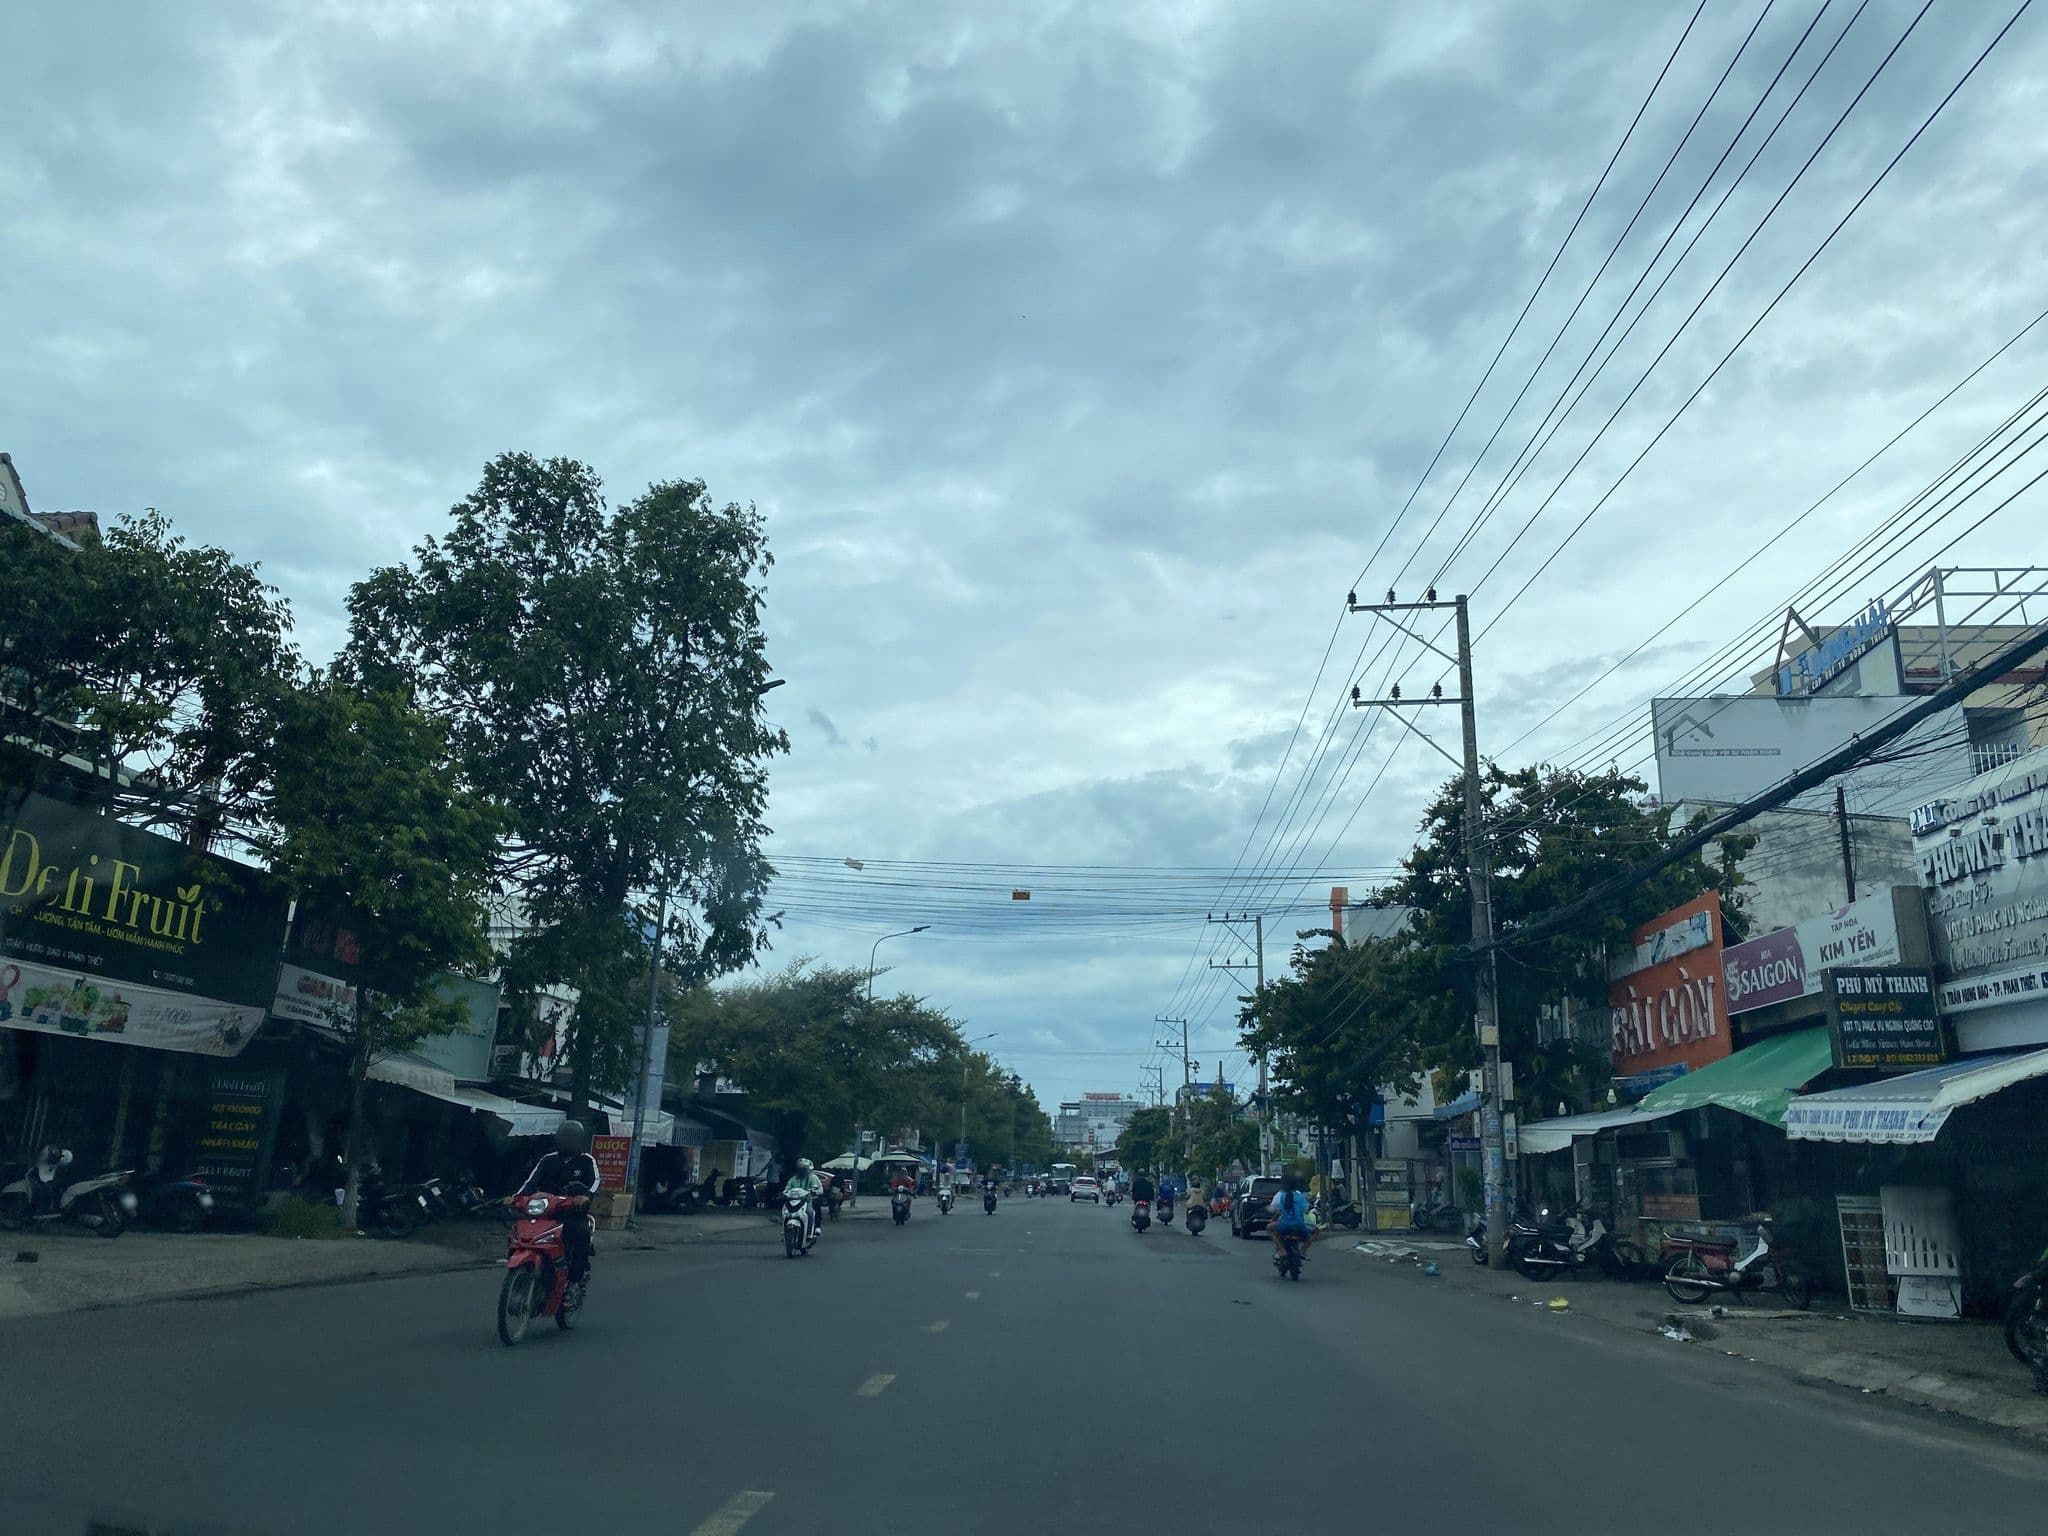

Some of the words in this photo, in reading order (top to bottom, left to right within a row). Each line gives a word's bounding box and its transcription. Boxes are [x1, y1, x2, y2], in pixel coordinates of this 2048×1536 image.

[102, 859, 207, 944] Fruit
[1819, 940, 1845, 963] KIM
[1847, 926, 1876, 954] YẾN
[1740, 955, 1798, 996] SAIGON
[1836, 973, 1861, 994] PHÚ
[1864, 973, 1883, 994] MỸ
[1885, 976, 1929, 993] THANH
[1660, 966, 1717, 1047] GÒN
